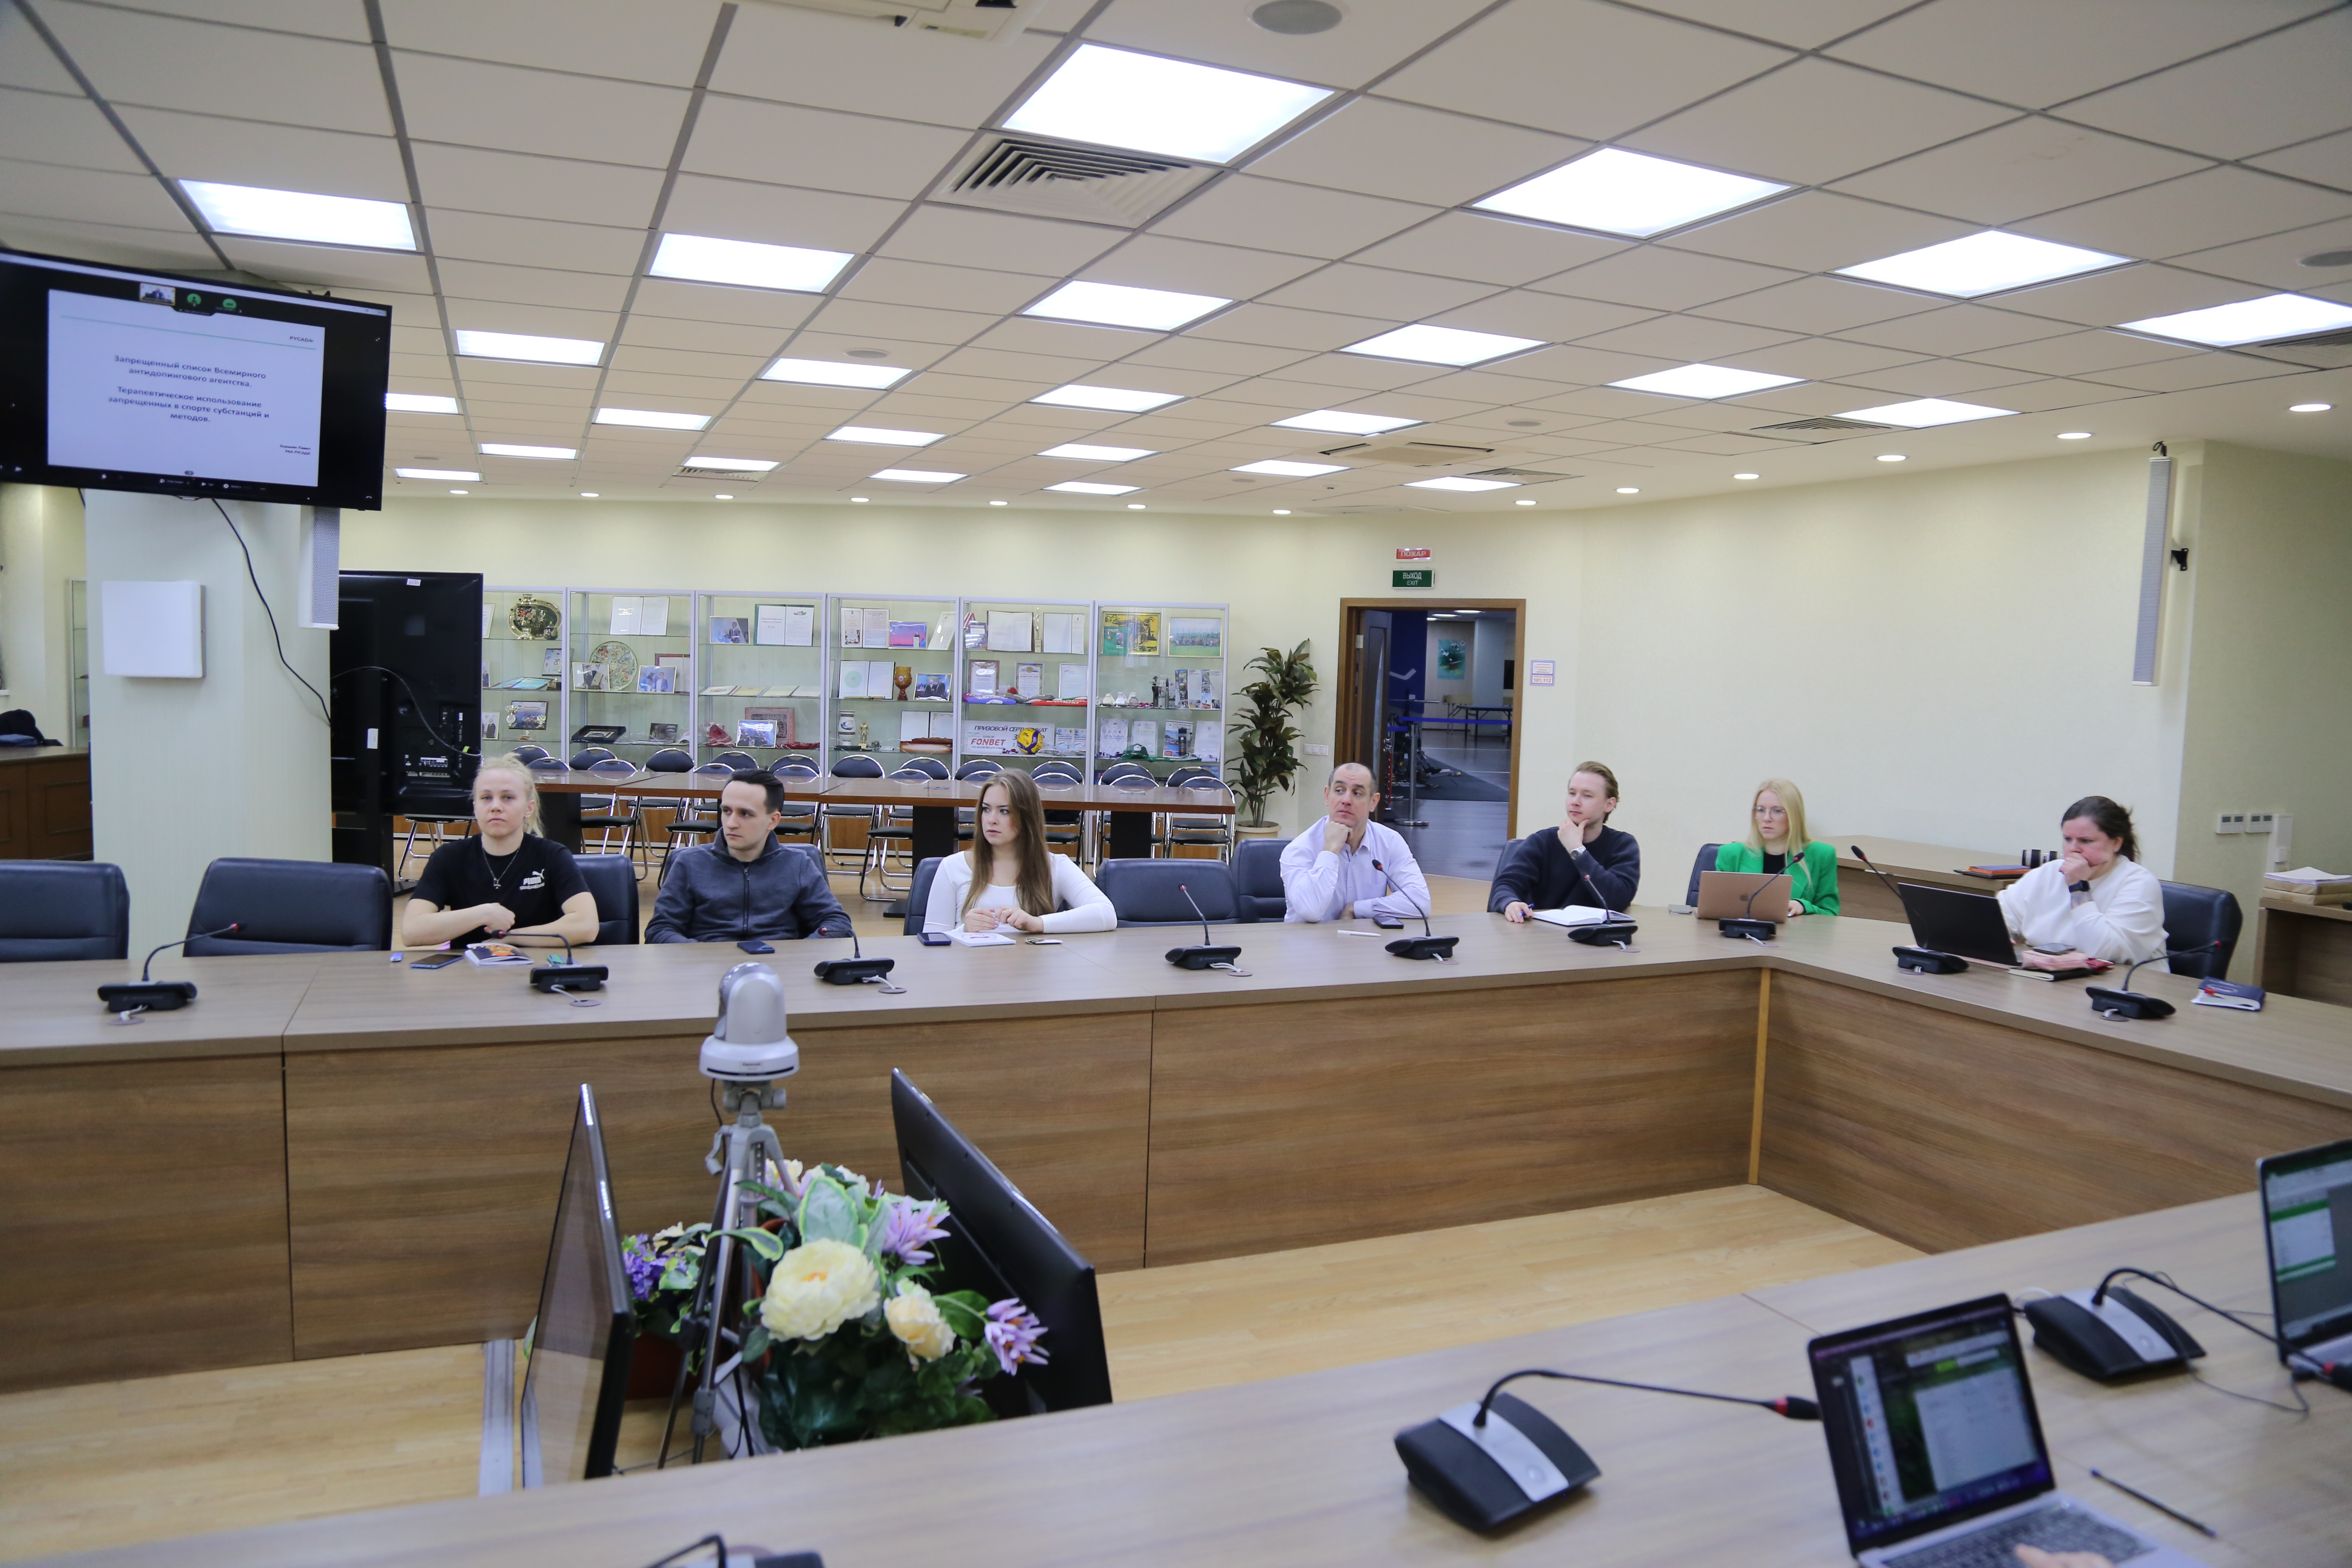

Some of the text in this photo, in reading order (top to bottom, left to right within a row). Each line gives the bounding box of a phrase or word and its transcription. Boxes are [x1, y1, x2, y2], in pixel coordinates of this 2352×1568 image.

[114, 355, 266, 379] Запрещенный список Всемирного
[129, 368, 252, 387] антидопингового агентства.
[117, 386, 262, 407] Терапевтическое использование
[109, 397, 172, 408] запрещенных
[213, 407, 262, 418] субстанций
[171, 413, 211, 422] методов.
